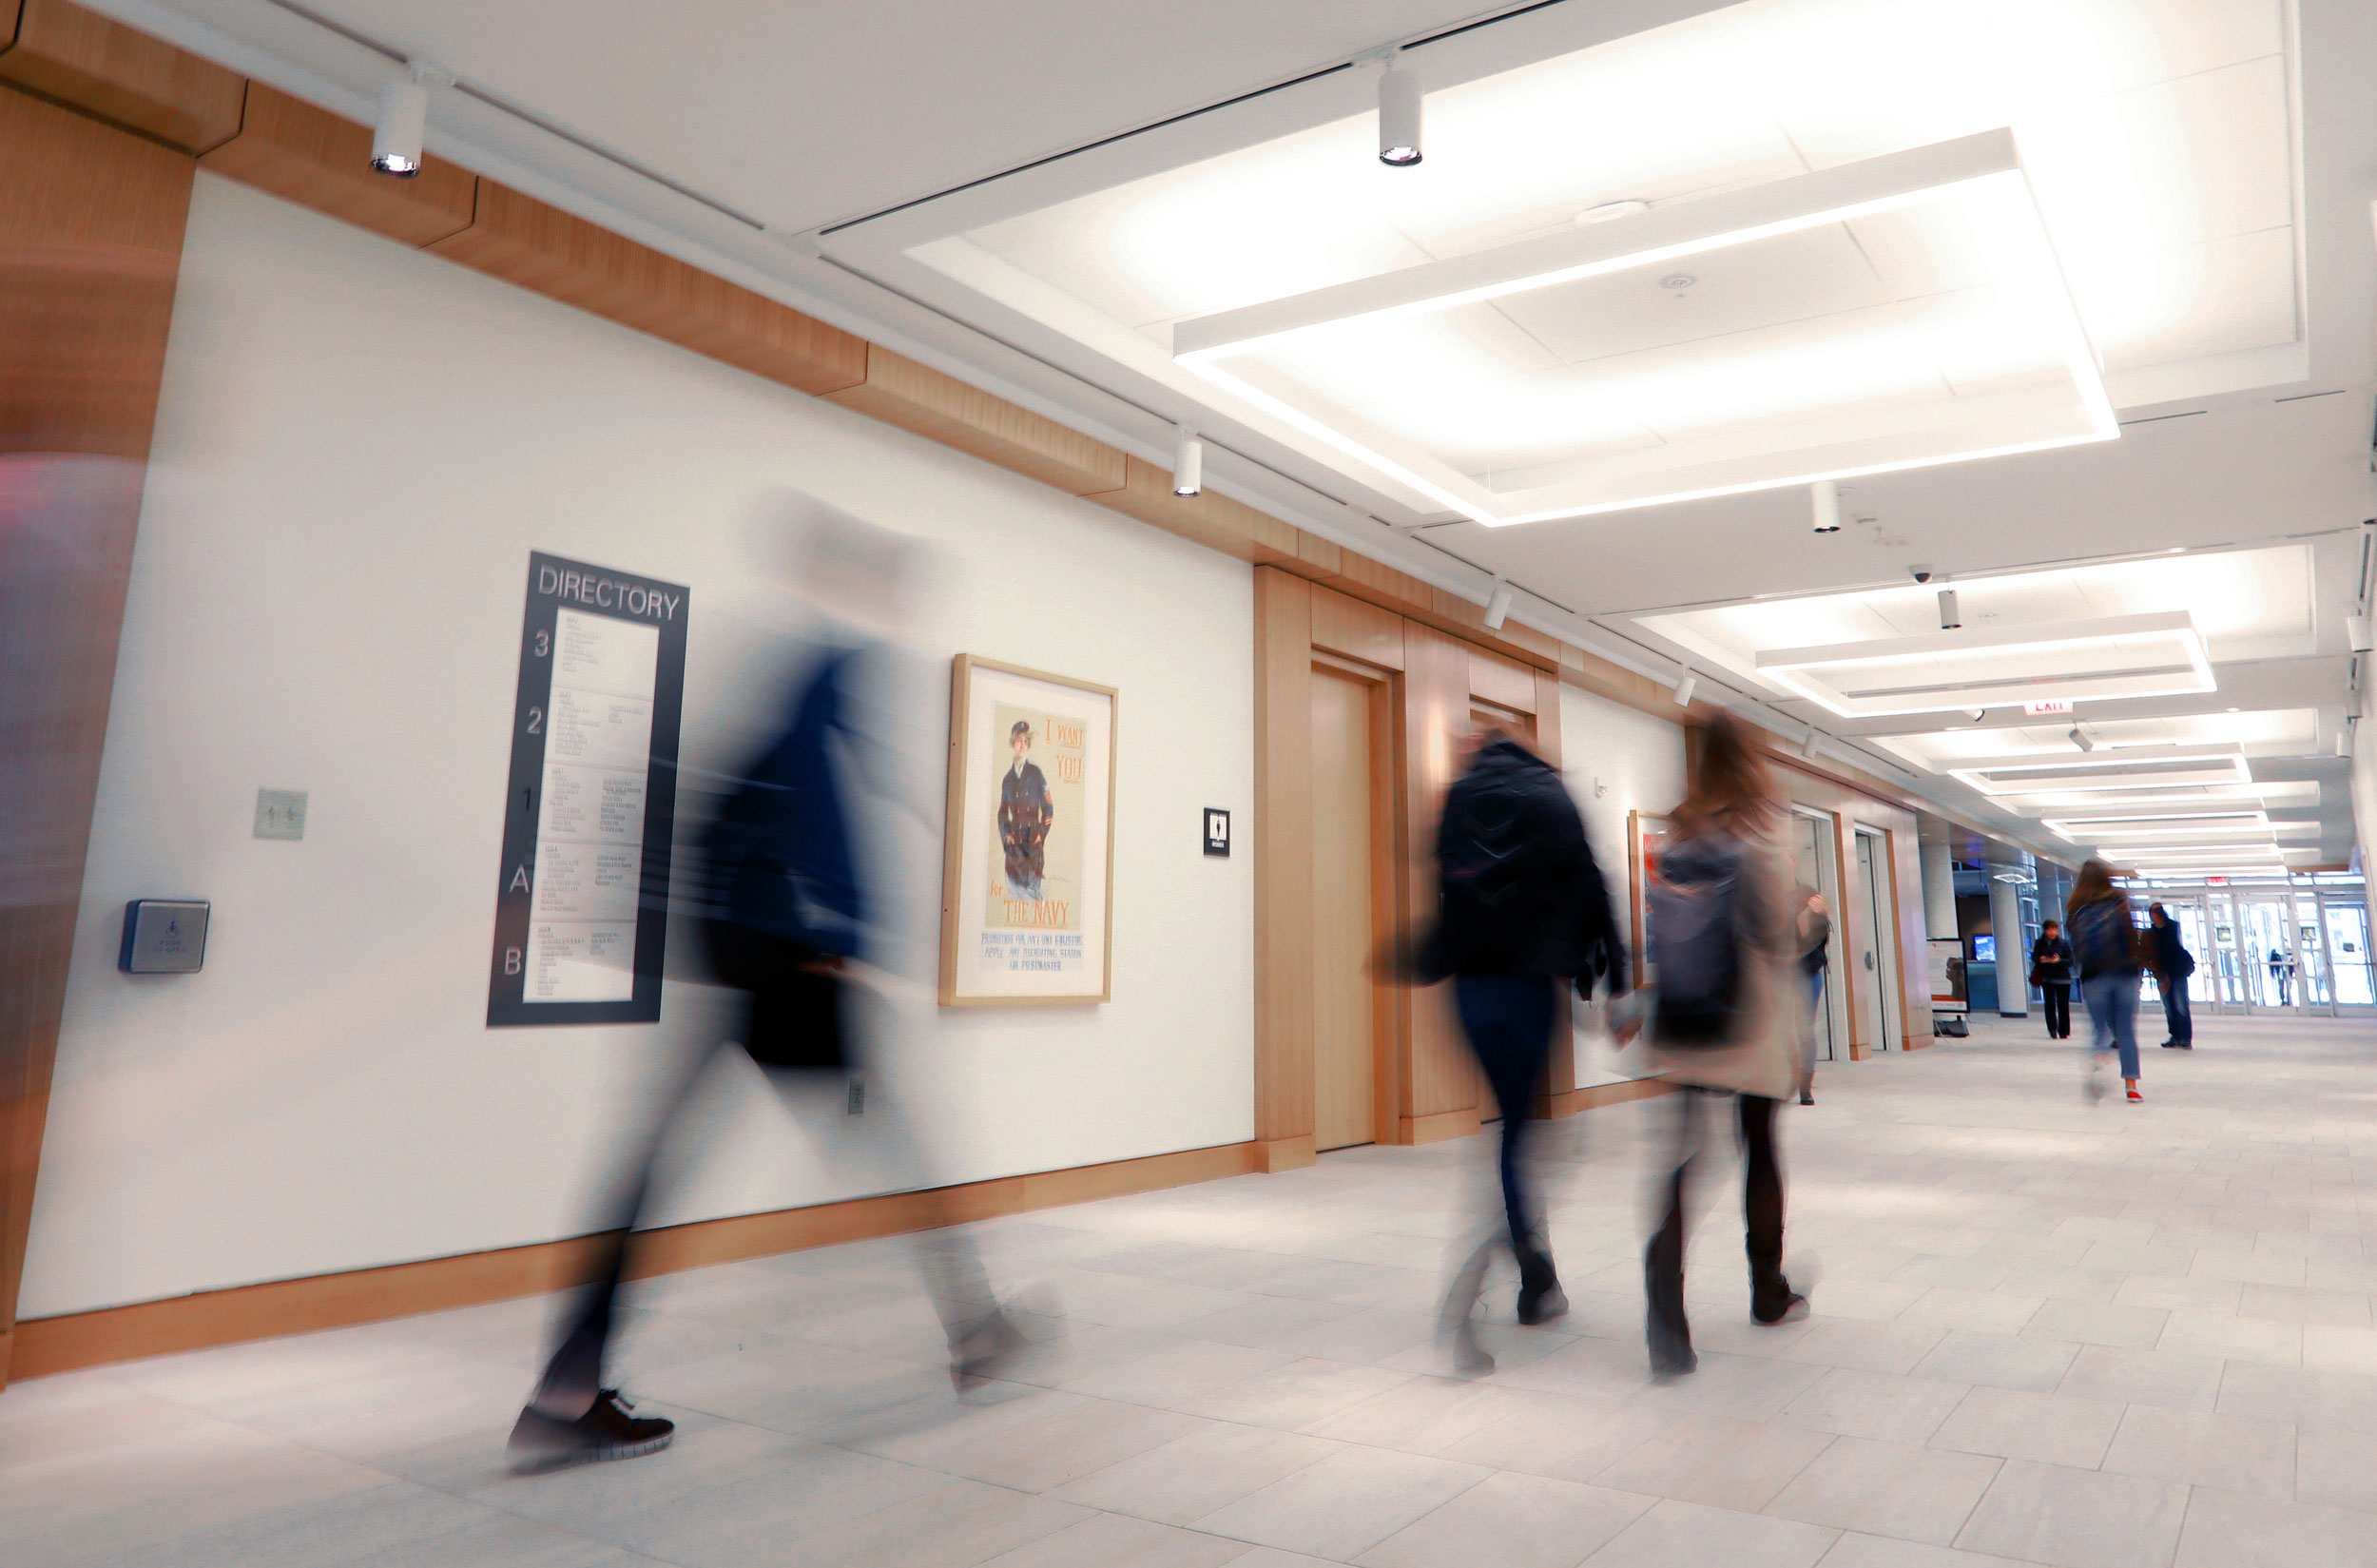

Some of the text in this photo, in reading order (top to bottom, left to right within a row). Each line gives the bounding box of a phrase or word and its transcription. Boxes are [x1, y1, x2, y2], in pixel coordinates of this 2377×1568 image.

[538, 564, 679, 620] DIRECTORY
[533, 629, 549, 657] 3
[527, 707, 542, 734] 2
[1045, 718, 1085, 746] I WANT
[1055, 754, 1082, 779] YOU
[524, 788, 531, 812] 1
[509, 864, 530, 893] A
[990, 880, 1003, 897] for
[1004, 898, 1070, 925] THE NAVY
[504, 947, 521, 975] B
